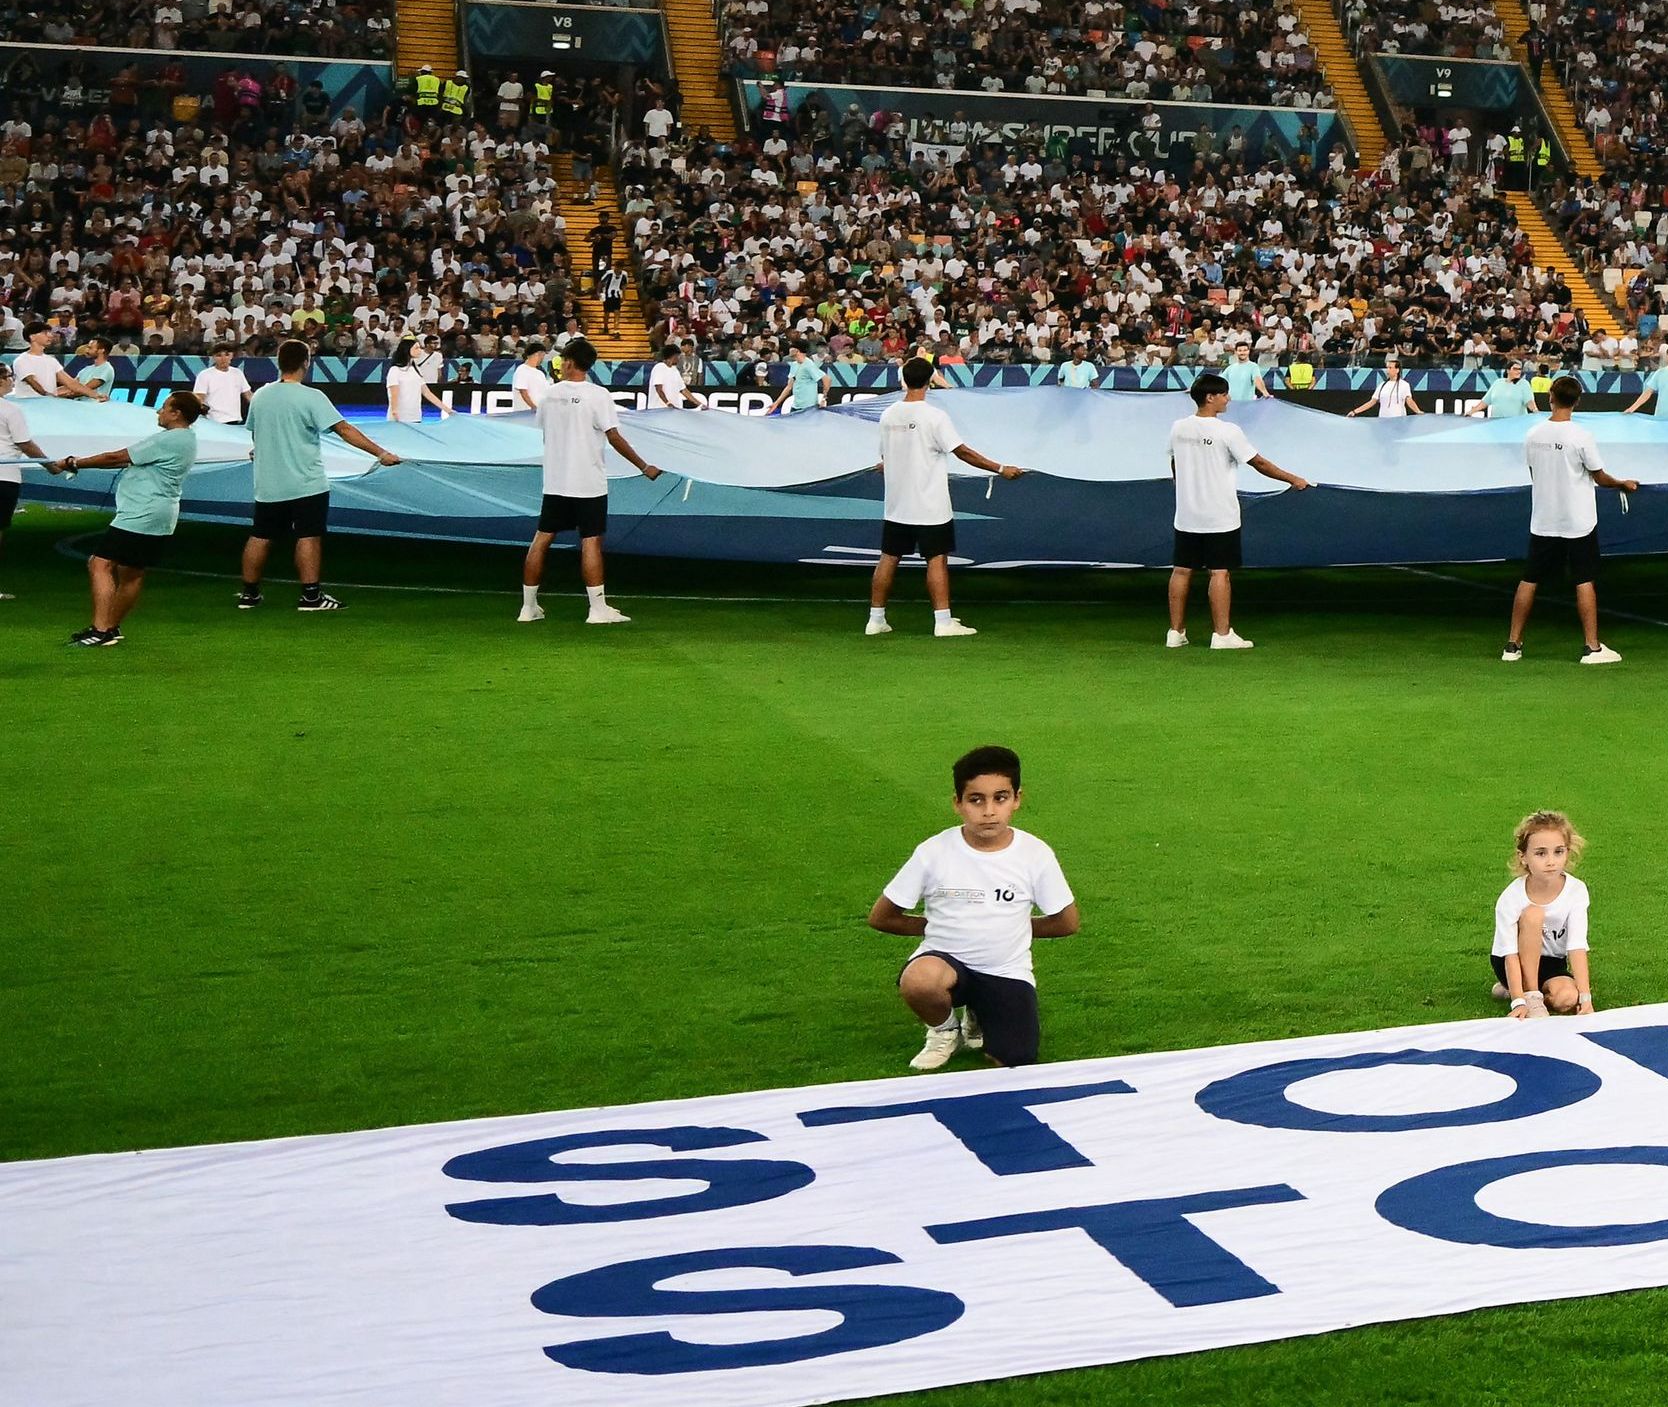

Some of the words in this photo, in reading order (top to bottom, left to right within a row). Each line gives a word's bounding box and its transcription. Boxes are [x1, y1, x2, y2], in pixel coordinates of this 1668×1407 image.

[552, 15, 573, 29] V8
[1436, 67, 1452, 79] V9
[994, 888, 1015, 902] 10
